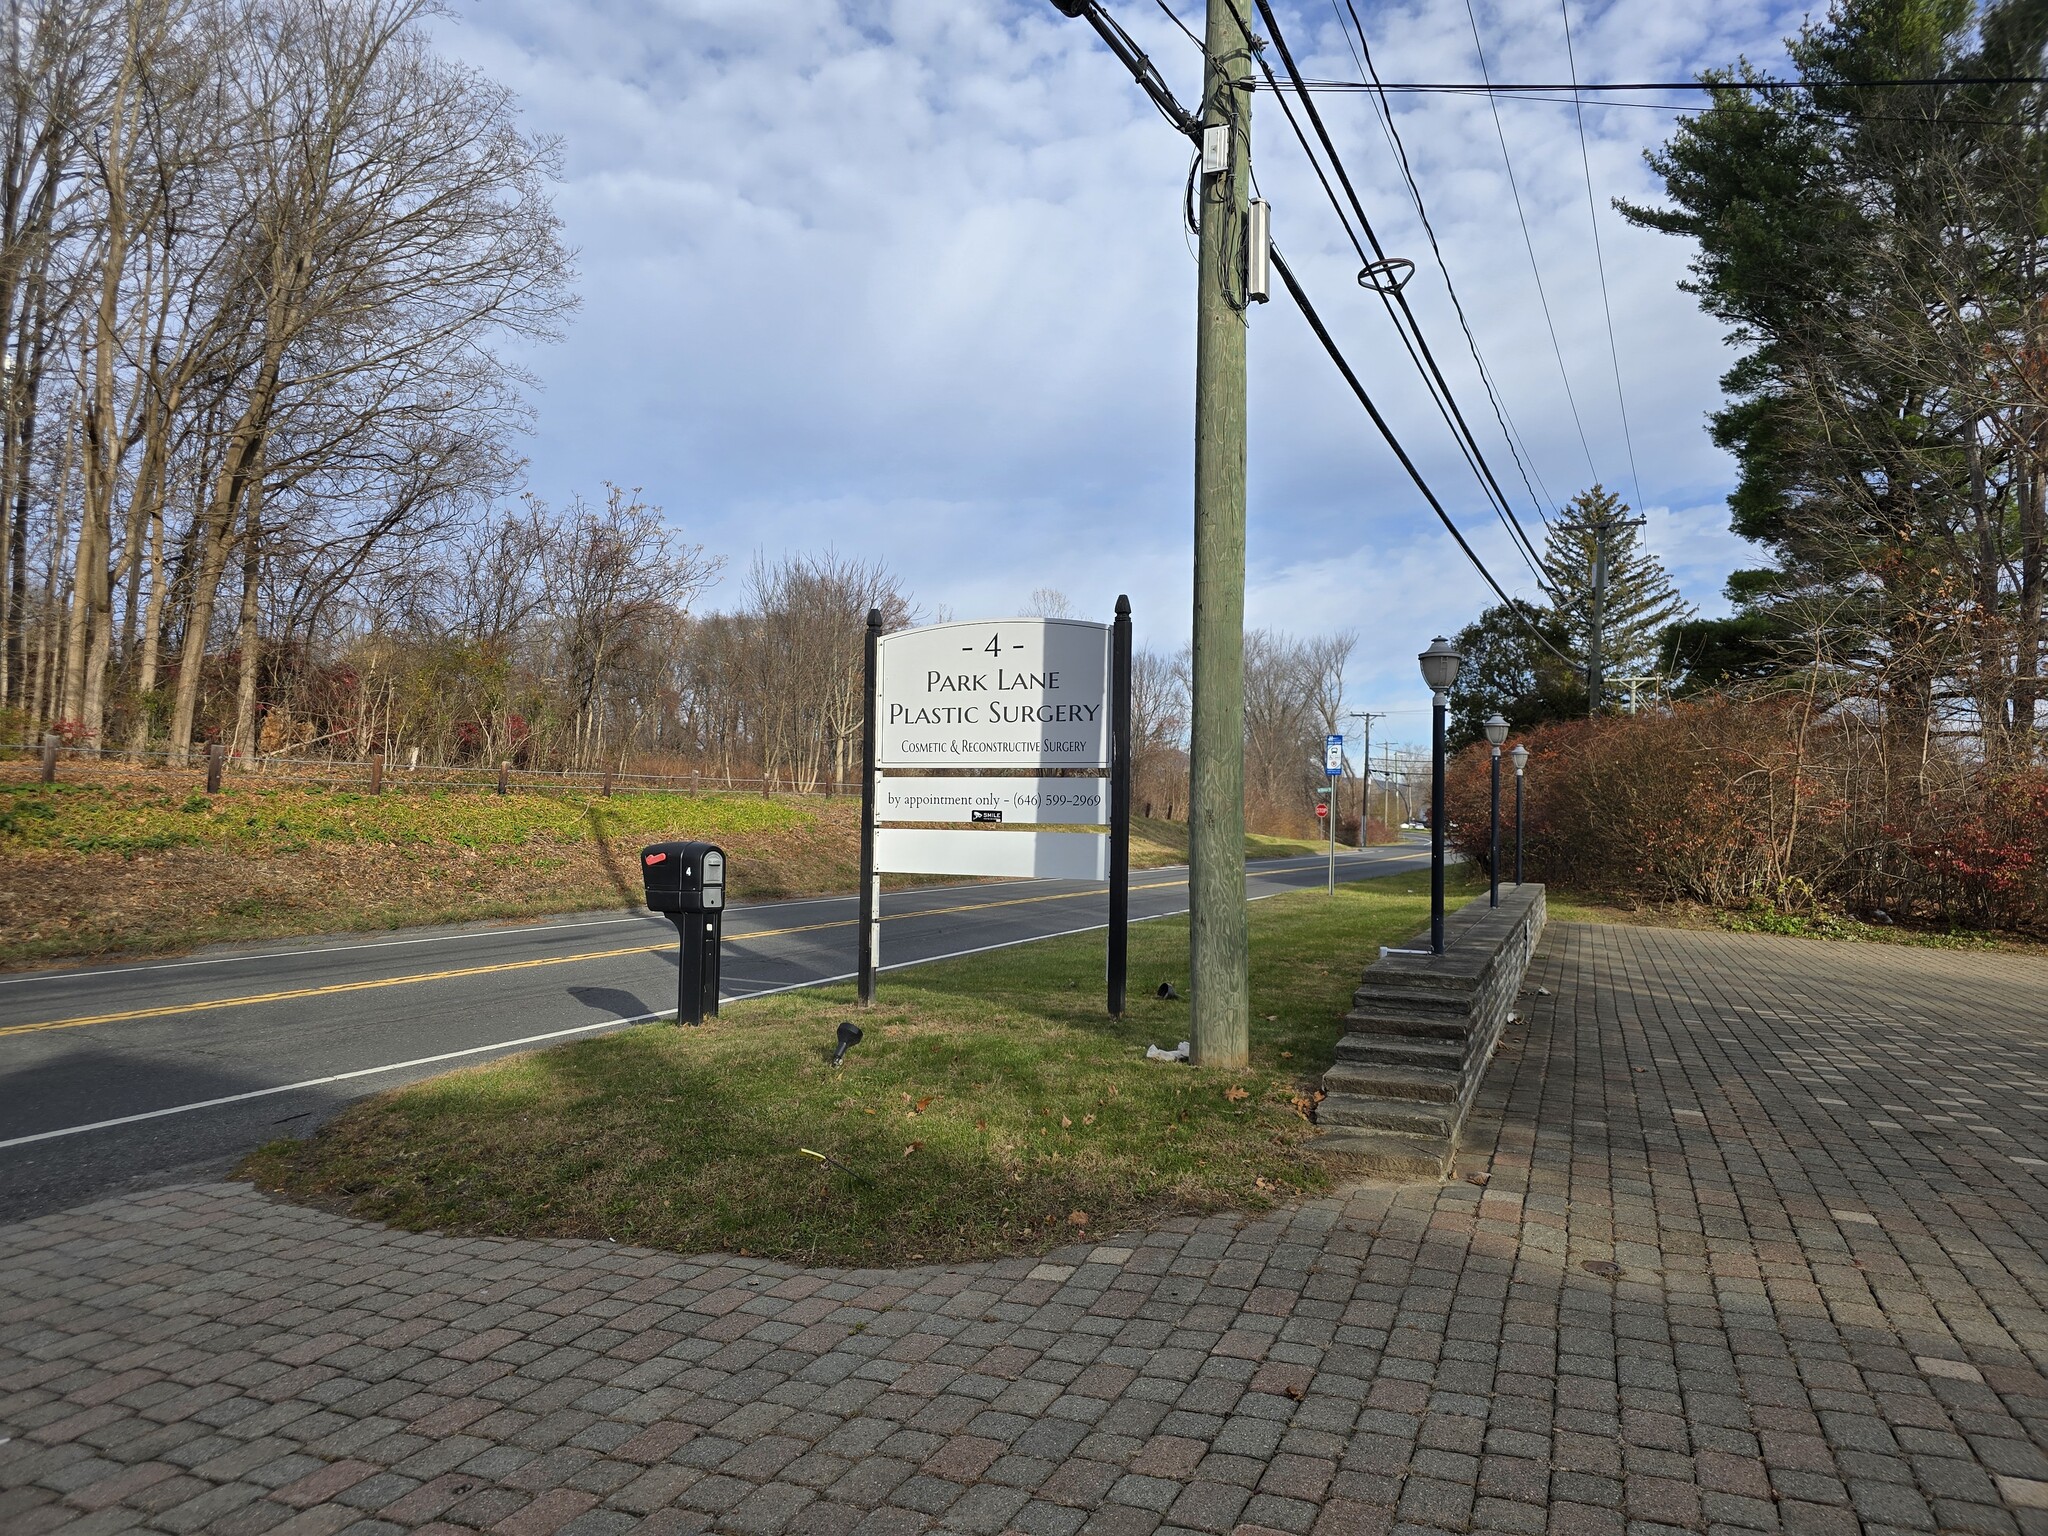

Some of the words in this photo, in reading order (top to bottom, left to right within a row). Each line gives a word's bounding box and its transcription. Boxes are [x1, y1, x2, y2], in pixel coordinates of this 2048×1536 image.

[984, 632, 1002, 658] 4
[927, 671, 988, 692] PARK
[998, 669, 1060, 691] LANE
[890, 703, 979, 725] PLASTIC
[989, 701, 1101, 724] SURGERY
[901, 740, 947, 753] COSMETIC
[950, 740, 961, 755] &
[962, 739, 1041, 753] RECONSTRUCTIVE
[1043, 739, 1087, 753] SURGERY
[888, 792, 901, 809] by
[904, 793, 972, 809] appointment
[975, 792, 1000, 810] only
[1013, 792, 1042, 810] (646)
[1045, 794, 1102, 807] 599-2969
[685, 867, 692, 876] 4
